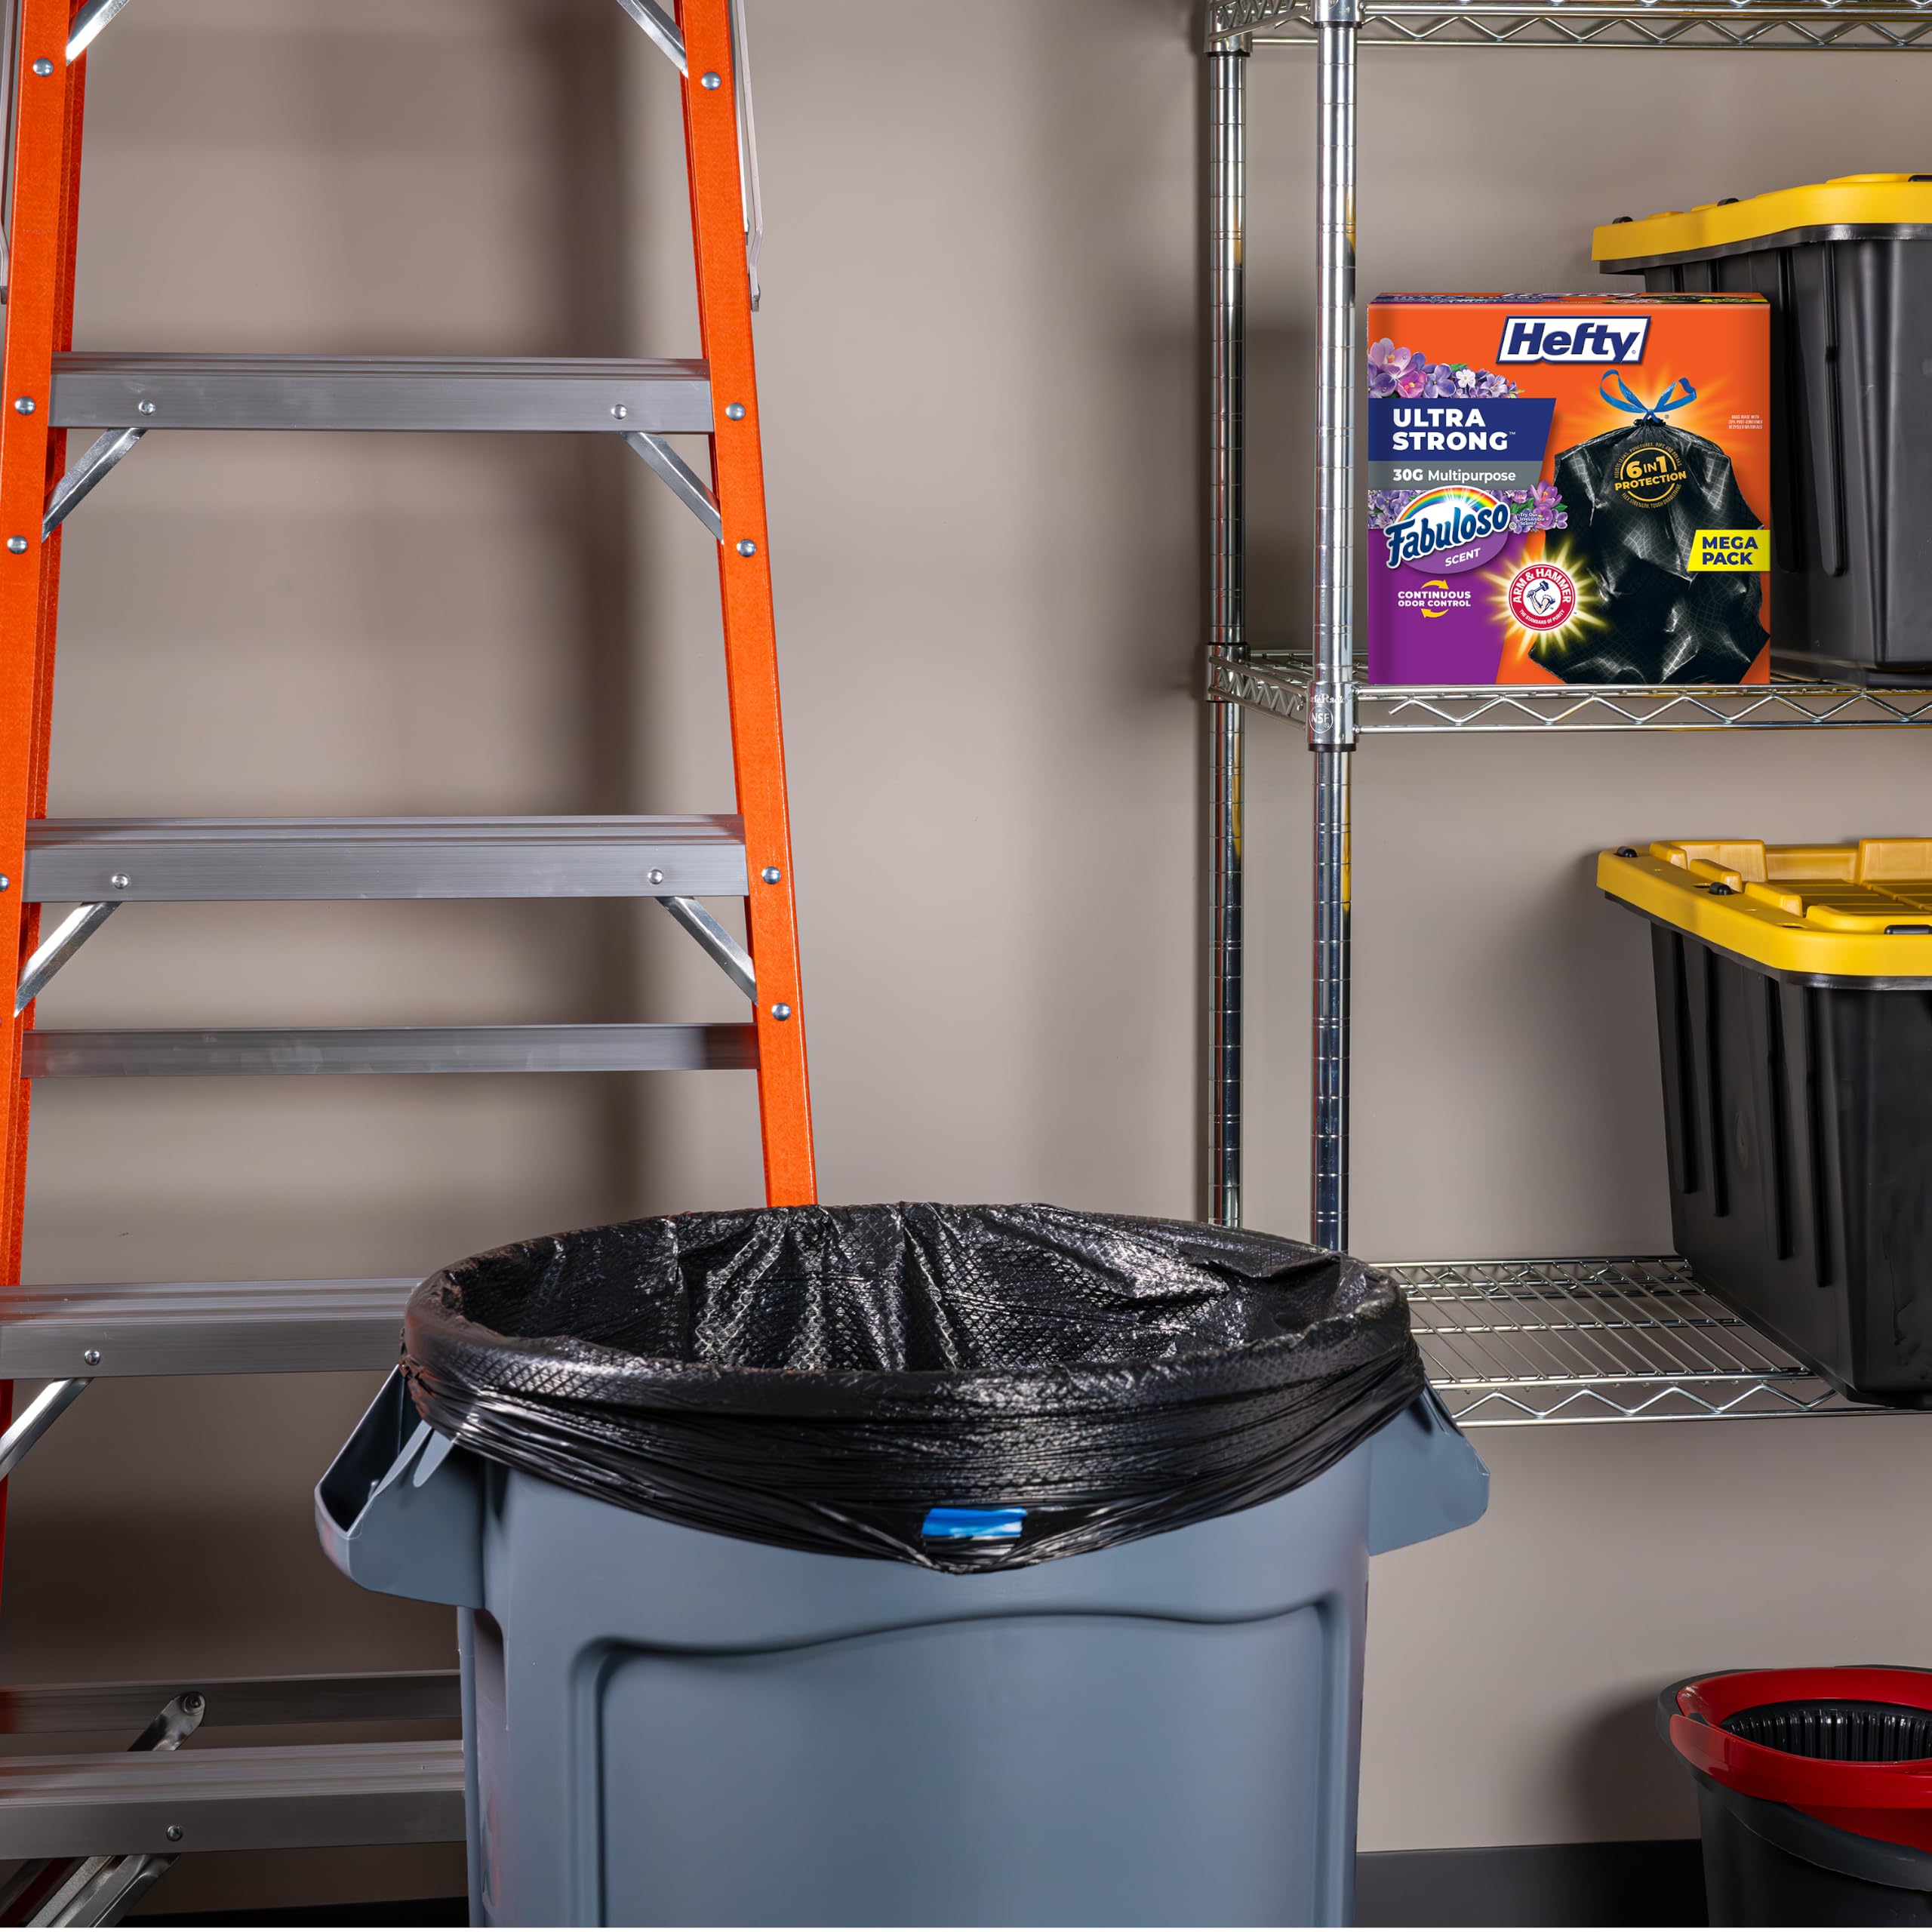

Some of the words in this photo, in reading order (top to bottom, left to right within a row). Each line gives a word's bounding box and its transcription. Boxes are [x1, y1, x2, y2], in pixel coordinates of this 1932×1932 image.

[1507, 322, 1641, 362] Hefty
[1393, 408, 1486, 427] ULTRA
[1393, 469, 1423, 481] 30G
[1428, 469, 1516, 484] Multipurpose
[1615, 471, 1687, 491] PROTECTION
[1386, 503, 1509, 567] Fabuloso
[1703, 537, 1758, 549] MEGA
[1445, 548, 1481, 566] SCENT
[1703, 552, 1753, 565] PACK
[1512, 577, 1527, 603] ARM
[1525, 571, 1535, 581] &
[1535, 568, 1571, 603] HAMMER
[1398, 591, 1471, 599] CONTINUOUS
[1311, 712, 1330, 723] NSF
